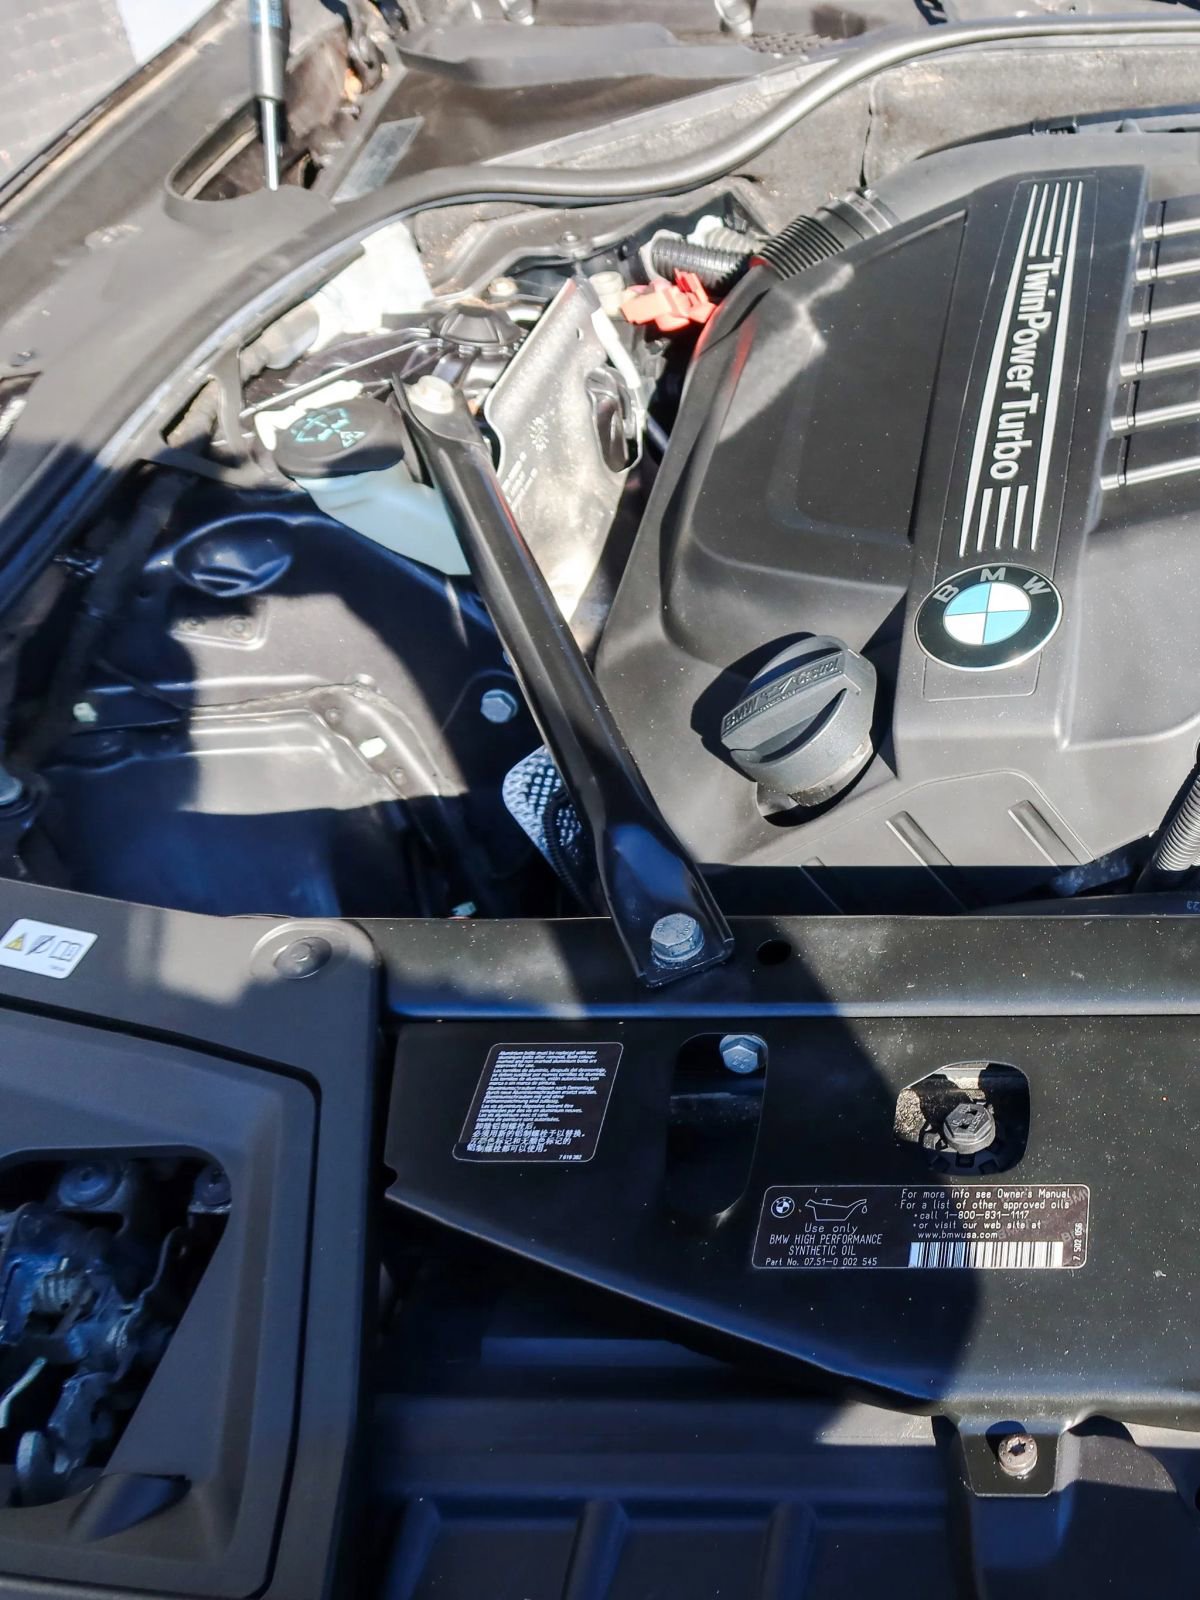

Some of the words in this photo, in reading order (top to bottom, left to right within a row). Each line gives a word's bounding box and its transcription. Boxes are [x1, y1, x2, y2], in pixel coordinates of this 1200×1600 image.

[1006, 254, 1062, 391] TwinPower
[990, 391, 1039, 481] Turbo
[933, 567, 1051, 604] BMW
[725, 698, 758, 730] BMW
[902, 1188, 917, 1198] For
[951, 1188, 970, 1198] info
[997, 1188, 1032, 1198] Owner's
[1038, 1188, 1070, 1198] Manual
[900, 1199, 916, 1209] For
[933, 1199, 950, 1209] list
[956, 1199, 967, 1209] of
[972, 1199, 997, 1209] other
[1003, 1199, 1045, 1210] approved
[1051, 1200, 1070, 1209] oils
[944, 1211, 1029, 1219] 1-800-831-1117
[804, 1222, 824, 1233] Use
[833, 1222, 858, 1234] only
[934, 1221, 956, 1229] visit
[984, 1221, 1001, 1229] web
[1007, 1221, 1025, 1229] site
[1032, 1220, 1041, 1229] at
[769, 1234, 790, 1245] BMW
[795, 1234, 815, 1245] HIGH
[820, 1234, 883, 1244] PERFORMANCE
[918, 1231, 998, 1239] www.bmwusa.com
[789, 1245, 836, 1256] SYNTHETIC
[842, 1245, 856, 1256] OIL
[765, 1258, 782, 1266] Part
[787, 1258, 799, 1266] No.
[804, 1258, 838, 1266] 07.51-0
[842, 1258, 857, 1266] 002
[862, 1258, 878, 1266] 545
